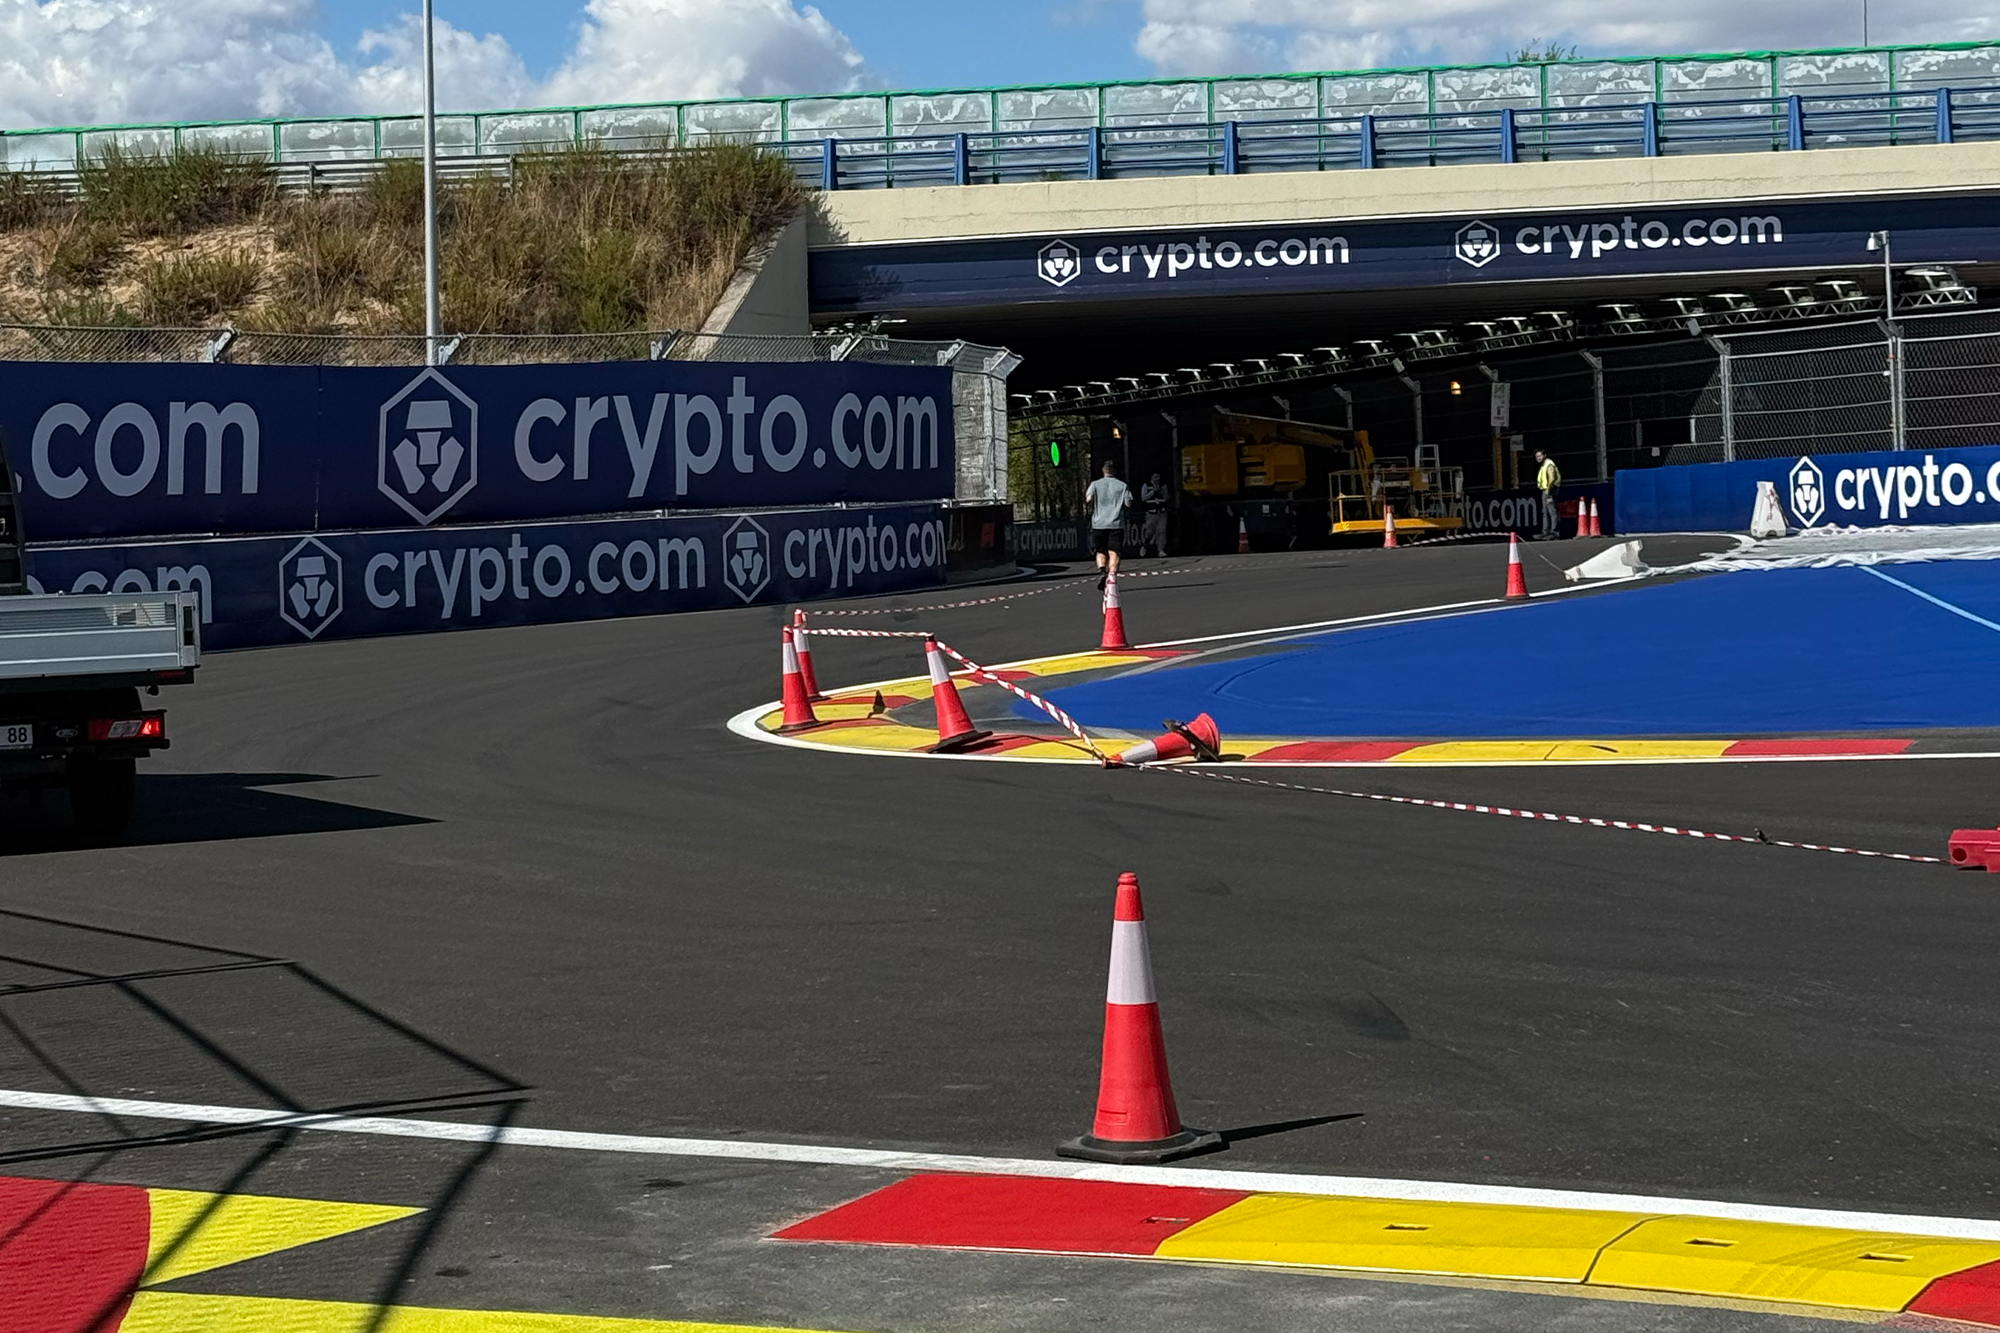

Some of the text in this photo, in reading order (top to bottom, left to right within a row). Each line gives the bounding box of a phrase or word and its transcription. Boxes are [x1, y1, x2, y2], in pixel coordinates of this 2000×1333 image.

[1095, 236, 1350, 279] crypto.com
[1516, 215, 1783, 259] crypto.com
[514, 376, 938, 498] crypto.com
[1020, 525, 1078, 556] crypto.com
[365, 532, 706, 619] crypto.com
[7, 726, 28, 744] 88
